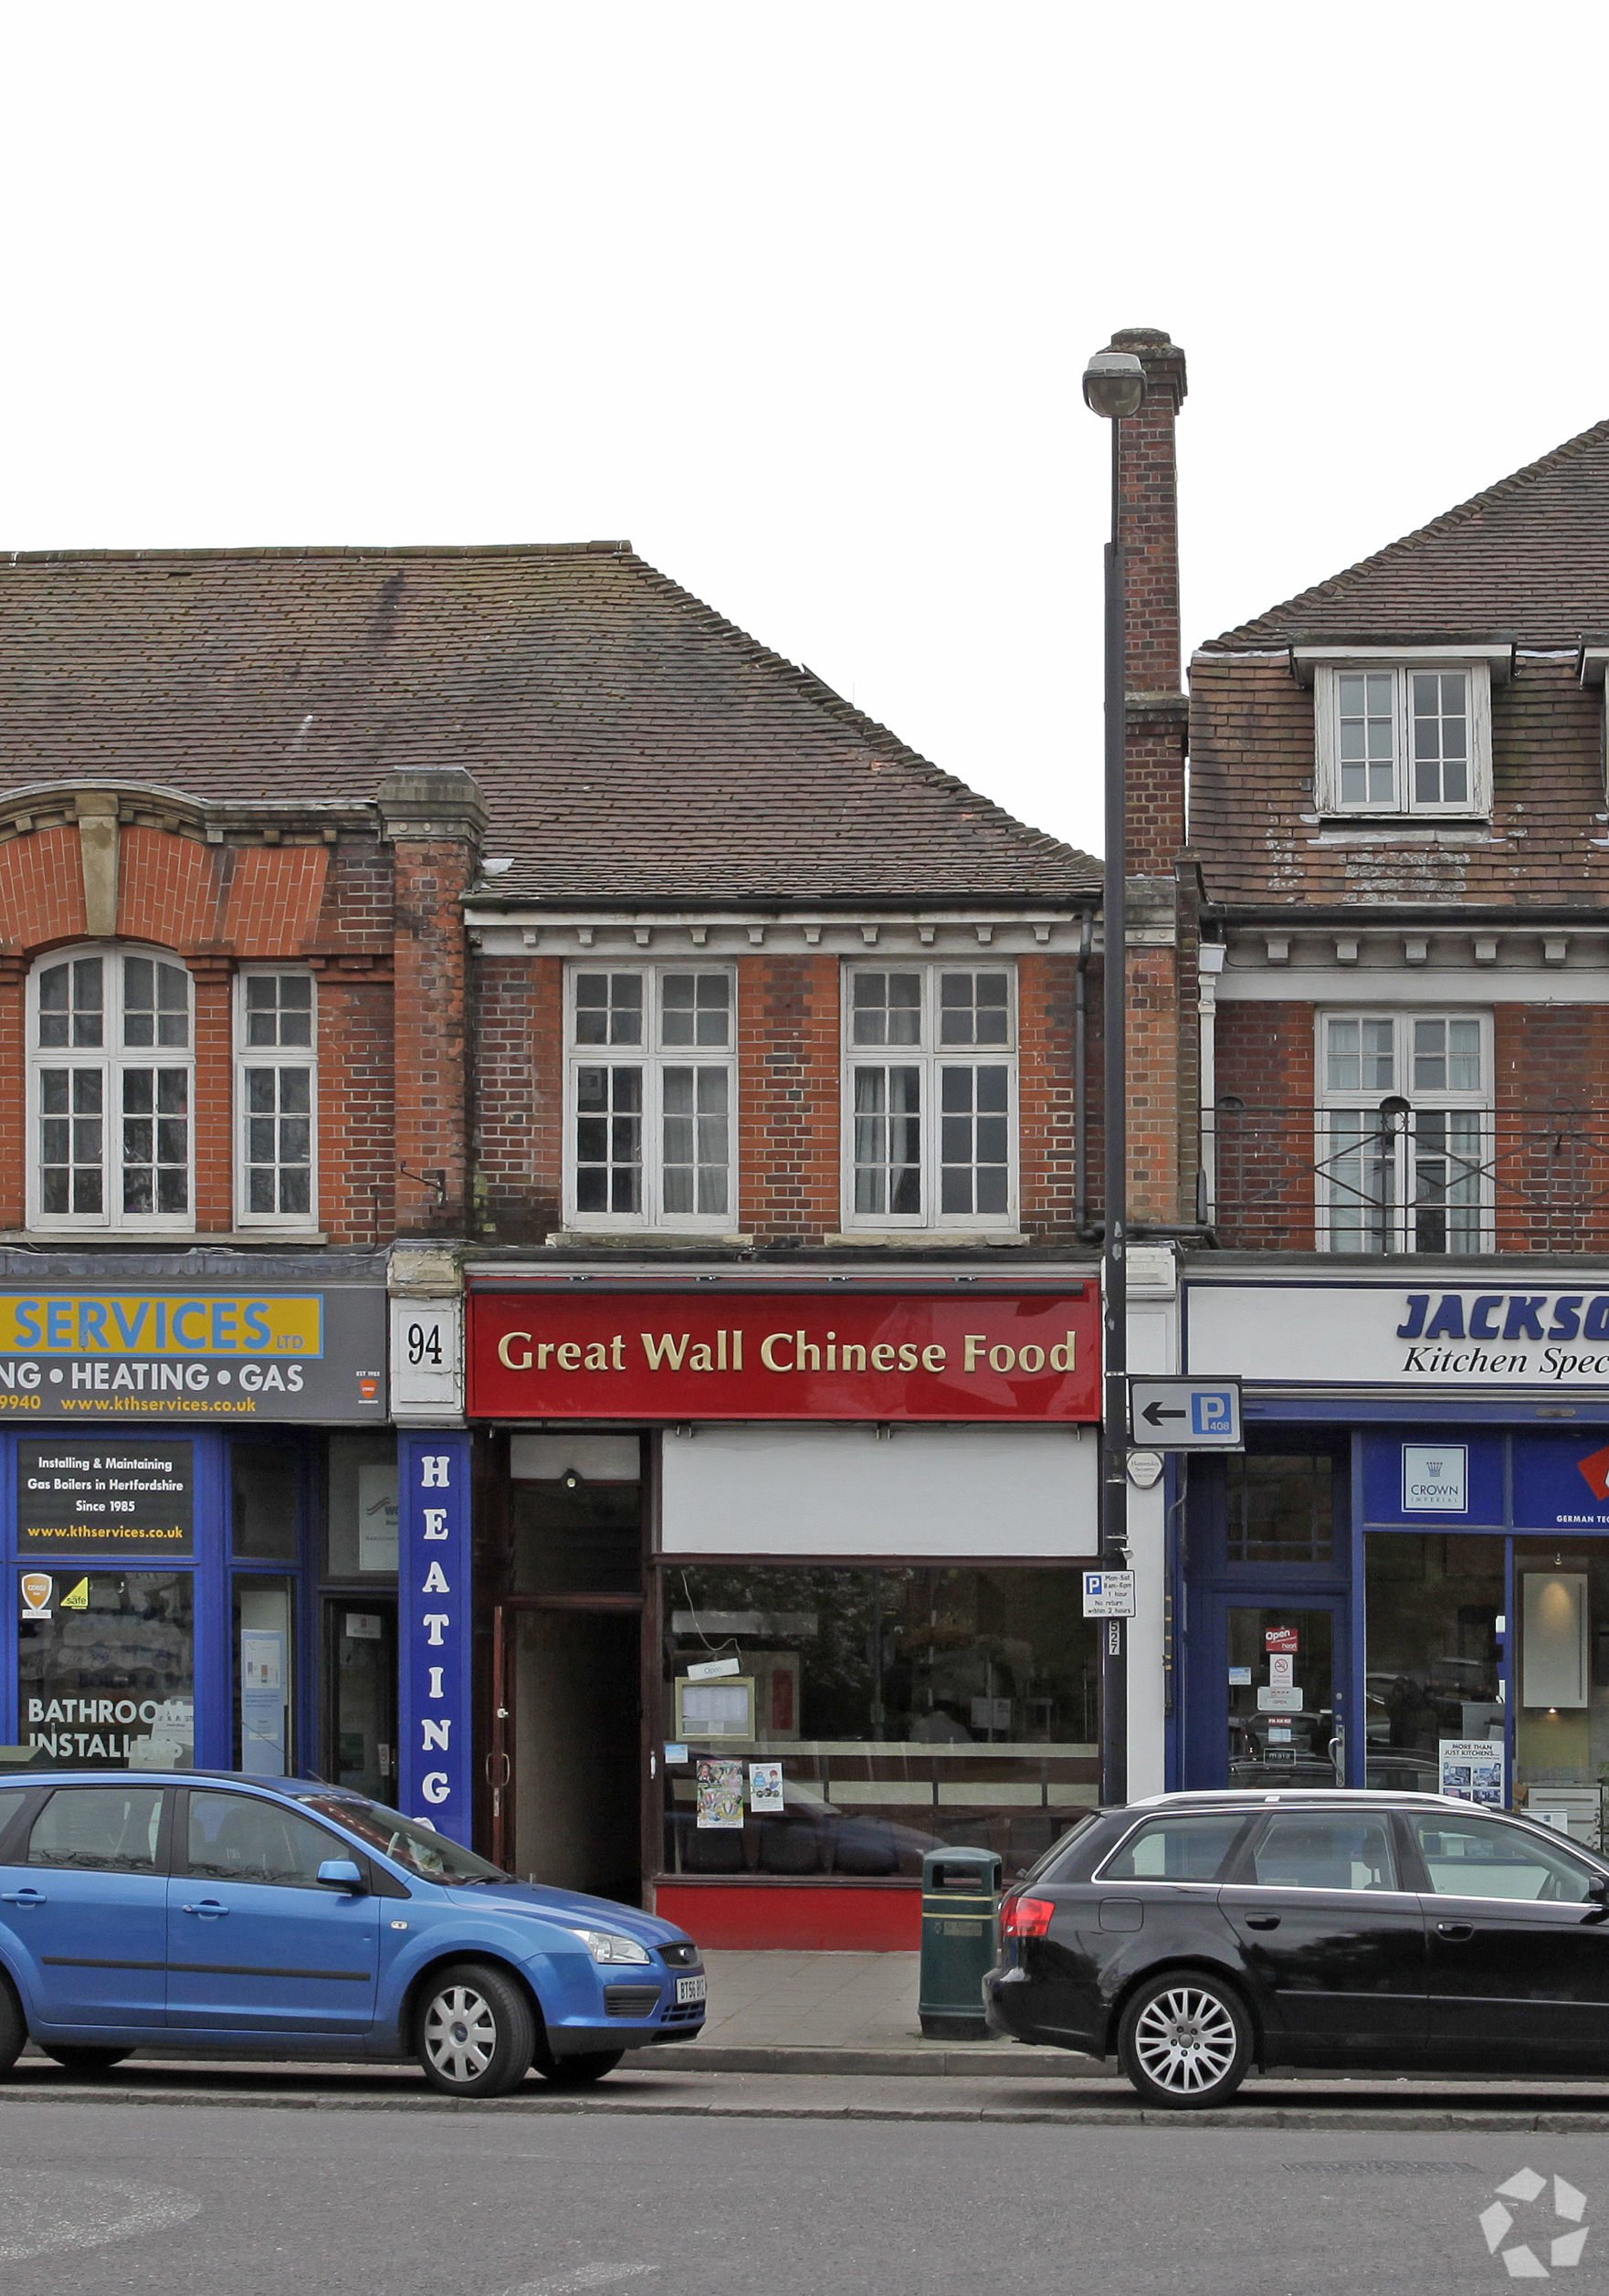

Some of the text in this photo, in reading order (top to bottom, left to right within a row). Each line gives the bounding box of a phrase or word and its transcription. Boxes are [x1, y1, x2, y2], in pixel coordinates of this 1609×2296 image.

[14, 1300, 305, 1350] SERVICES LTD
[1396, 1294, 1609, 1340] JACKSO
[407, 1323, 443, 1365] 94
[498, 1329, 1077, 1373] Great Wall Chinese Food
[1401, 1347, 1609, 1380] Kitchen Spec
[71, 1362, 210, 1391] HEATING
[239, 1364, 304, 1392] GAS
[60, 1396, 257, 1413] www.kthservices.co.uk
[1200, 1396, 1225, 1431] P
[1210, 1421, 1230, 1431] 408
[38, 1457, 173, 1472] Installing & Maintaining
[27, 1478, 184, 1491] Gas Boilers in Hertfordshire
[1411, 1484, 1458, 1496] CROWN
[76, 1500, 135, 1512] Since 1985
[1556, 1515, 1594, 1523] GERMAN
[26, 1525, 184, 1539] www.kthservices.co.uk
[1088, 1577, 1099, 1594] P
[67, 1596, 86, 1605] safe
[420, 1455, 451, 1804] HEATING
[1266, 1629, 1290, 1640] Open
[704, 1667, 722, 1675] Open
